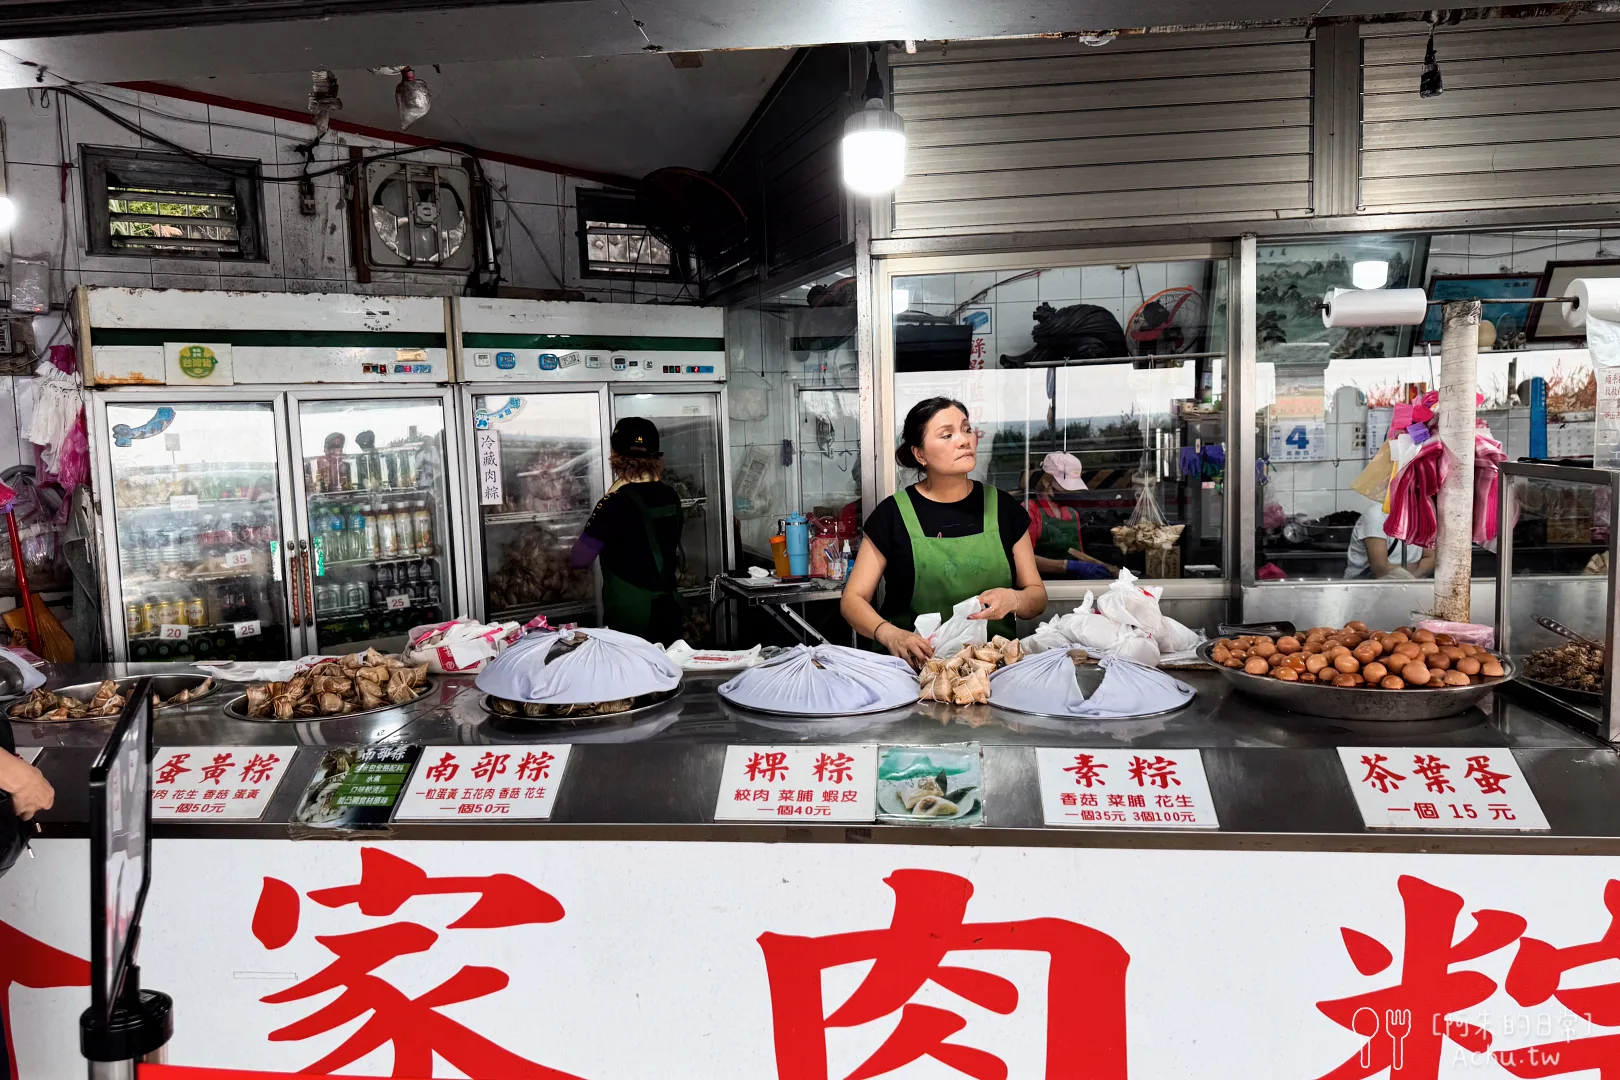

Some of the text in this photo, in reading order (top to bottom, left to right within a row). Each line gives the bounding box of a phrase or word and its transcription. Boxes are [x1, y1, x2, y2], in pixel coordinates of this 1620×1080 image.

[1285, 425, 1309, 450] 4
[481, 434, 499, 500] 冷藏肉粽
[232, 554, 247, 564] 35
[392, 599, 404, 607] 25
[166, 628, 181, 638] 20
[240, 625, 255, 635] 25
[156, 753, 280, 785] 蛋黃粽
[426, 751, 555, 783] 南部粽
[744, 752, 855, 784] 粿粽
[1063, 753, 1181, 789] 素粽
[1360, 754, 1512, 794] 茶葉蛋
[172, 789, 199, 799] 花生
[202, 789, 231, 800] 香菇
[232, 789, 261, 800] 蛋黃
[416, 787, 546, 799] 一粒蛋黃 五花肉 香菇 花生
[734, 788, 858, 803] 絞肉 菜脯 蝦皮
[1060, 792, 1195, 808] 香菇 菜脯 花生
[159, 803, 227, 813] 一個50元
[439, 803, 511, 814] 一個50元
[757, 805, 831, 816] 一個40元
[1387, 802, 1516, 820] 一個 15 元
[1065, 810, 1196, 822] 一個35元 3個100元
